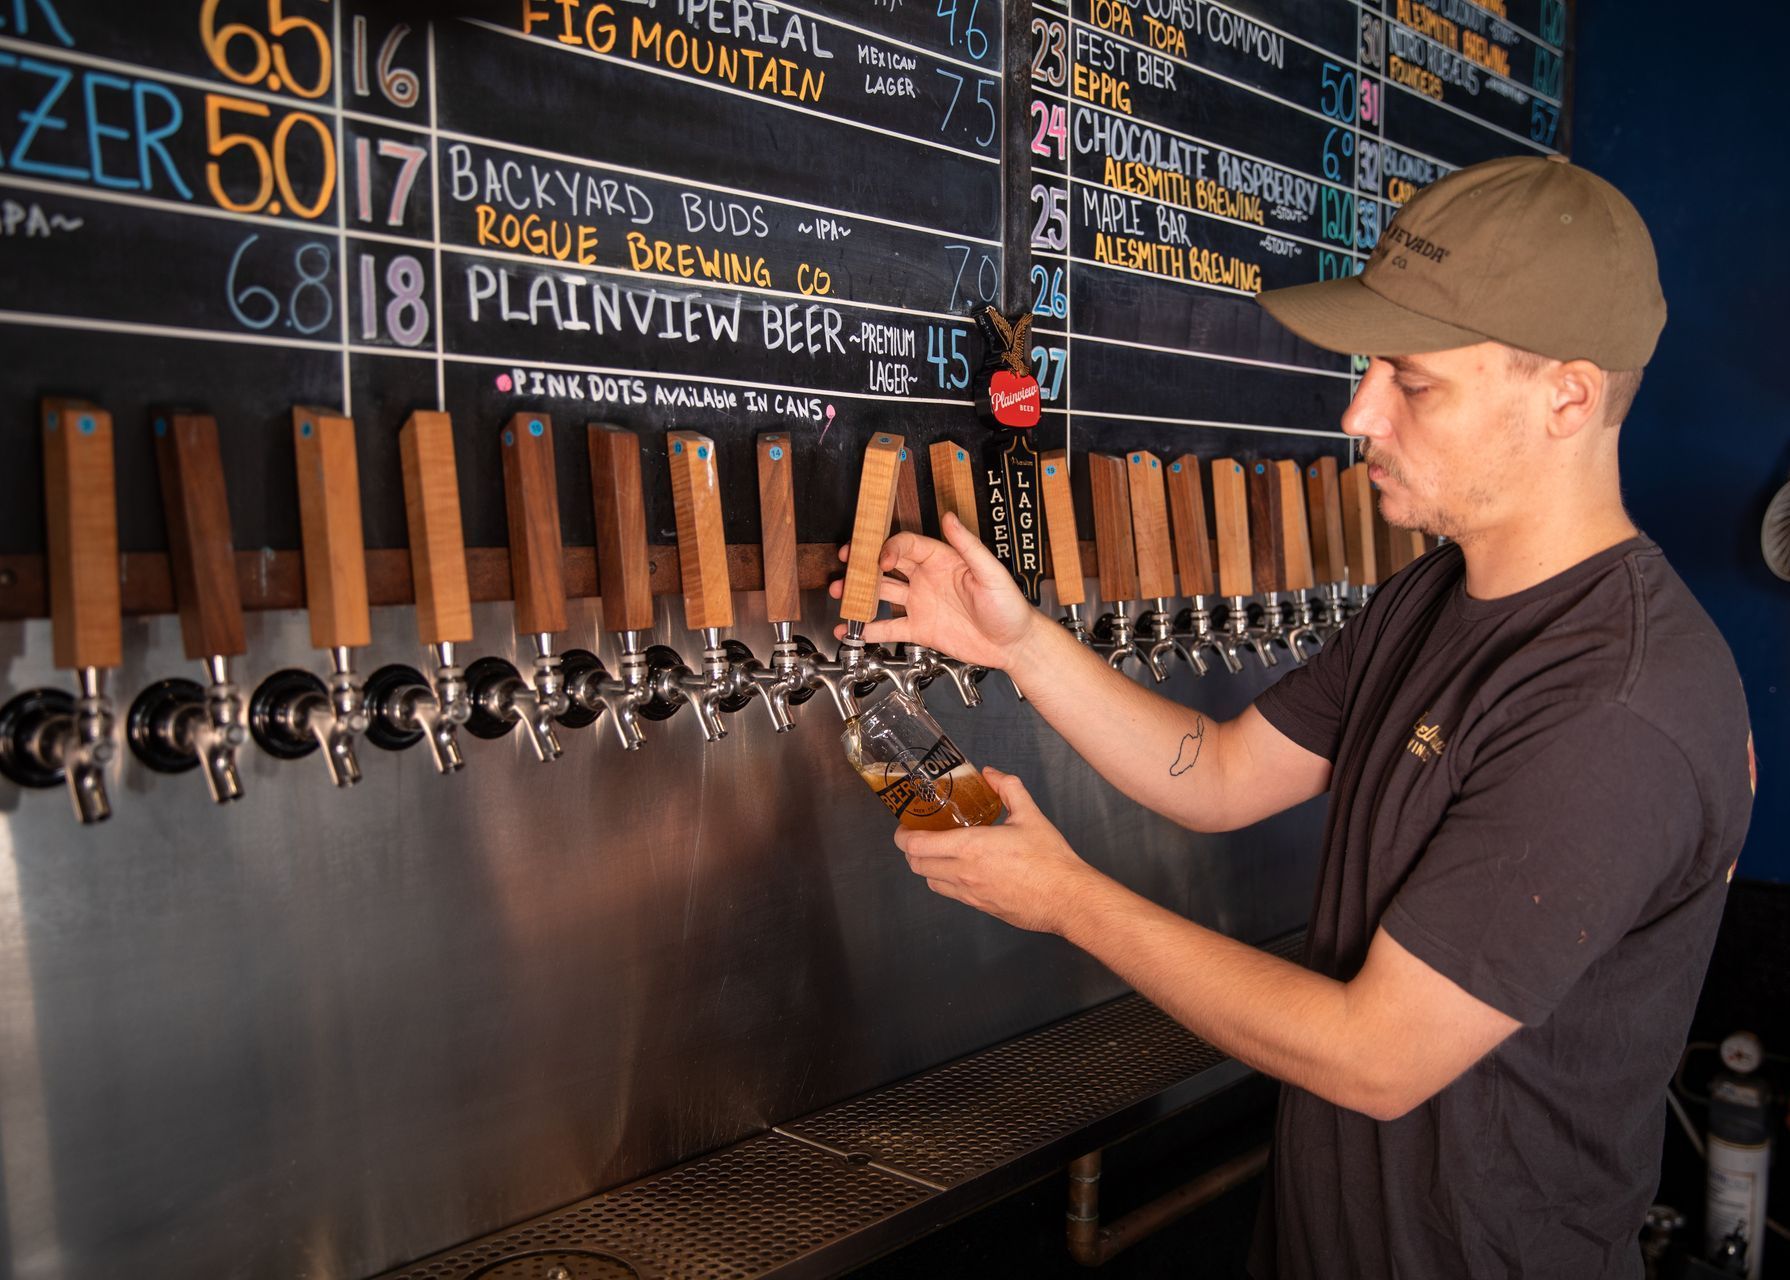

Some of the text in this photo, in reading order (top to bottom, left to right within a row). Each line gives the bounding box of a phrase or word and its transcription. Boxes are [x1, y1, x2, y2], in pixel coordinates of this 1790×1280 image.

[200, 0, 332, 98] 6.5
[353, 15, 419, 107] 16
[620, 0, 833, 58] PERIAL
[631, 16, 825, 102] MOUNTAIN
[857, 44, 916, 71] MEXICAN
[937, 0, 988, 59] 4.6
[1031, 17, 1067, 87] 23
[1076, 28, 1177, 92] FEST BIER
[1142, 14, 1188, 58] TOPA
[1207, 8, 1285, 70] COMMON
[1360, 13, 1382, 69] 30
[865, 74, 915, 99] LAGER
[936, 68, 996, 147] 7.5
[1074, 62, 1132, 116] EPPIG
[1320, 62, 1355, 124] 5.0
[1360, 79, 1380, 127] 31
[0, 53, 193, 200] ZER
[206, 94, 336, 219] 5.0
[1031, 100, 1067, 160] 24
[355, 138, 427, 226] 17
[449, 144, 654, 224] BACKYARD
[681, 192, 769, 237] BUDS
[1074, 107, 1209, 179] CHOCOLATE
[1217, 153, 1319, 217] RASPBERRY
[1103, 156, 1265, 227] ALESMITH BREWING
[1358, 139, 1379, 193] 32
[1383, 143, 1436, 184] BLONDE
[0, 201, 84, 237] PA~
[1031, 184, 1067, 250] 25
[1083, 187, 1192, 247] MAPLE BAR
[475, 204, 835, 296] ROGUE BREWING CO.
[944, 244, 998, 311] 7.0
[1095, 233, 1262, 294] ALESMITH BREWING
[226, 234, 332, 334] 6.8
[360, 254, 429, 346] 18
[467, 264, 846, 355] PLAINVIEW BEER
[1031, 265, 1067, 320] 26
[926, 325, 969, 390] 4.5
[1031, 346, 1067, 401] 27
[512, 367, 584, 398] PINK
[594, 374, 645, 404] DOTS
[744, 391, 768, 413] IN
[775, 393, 823, 421] CANS
[991, 383, 1039, 412] Plainview
[1019, 404, 1034, 413] BEER
[987, 470, 1010, 558] LAGER
[1016, 471, 1036, 570] LAGER
[880, 736, 961, 816] BEER TOWN
